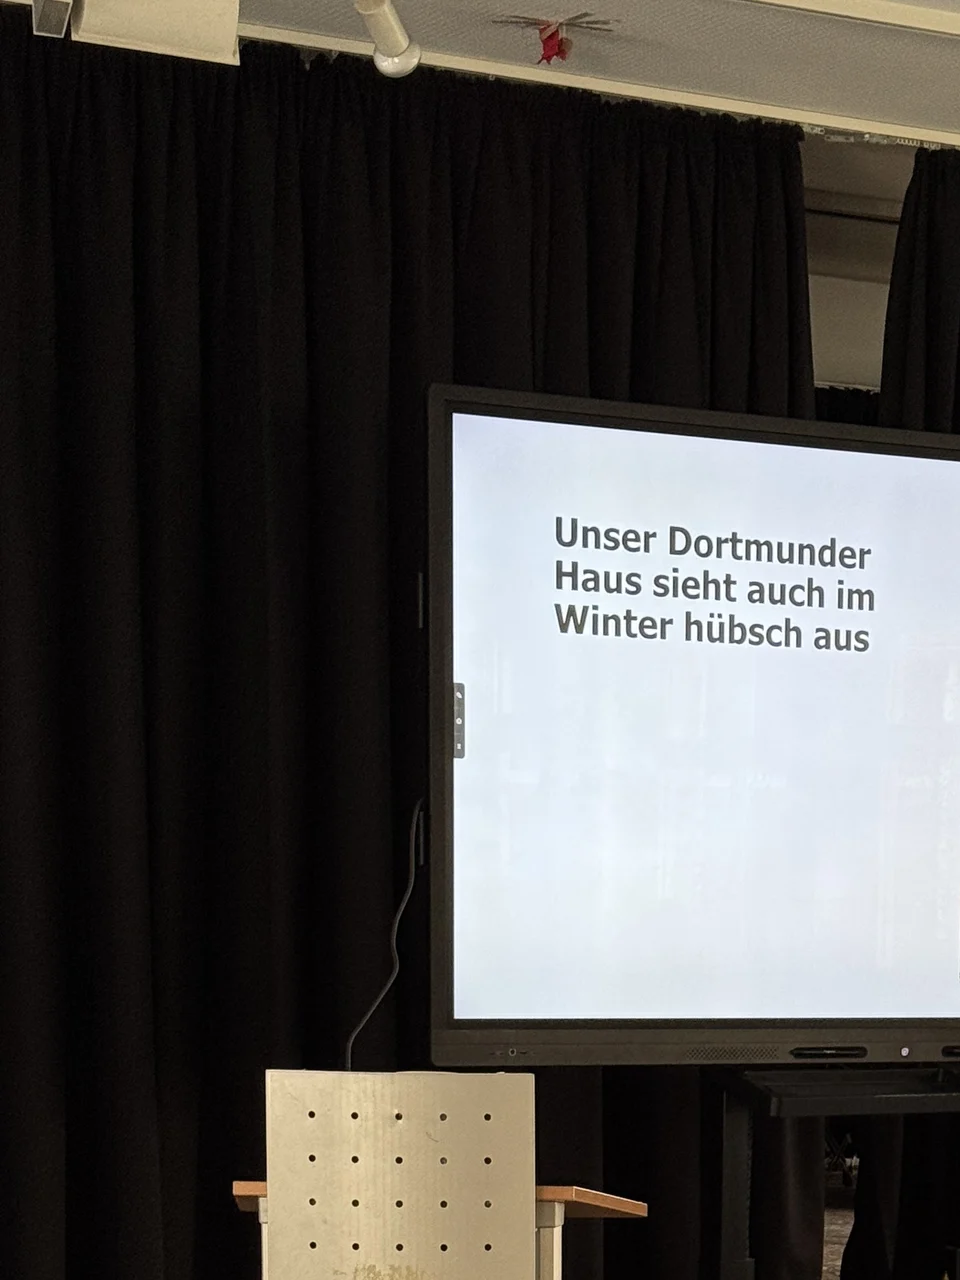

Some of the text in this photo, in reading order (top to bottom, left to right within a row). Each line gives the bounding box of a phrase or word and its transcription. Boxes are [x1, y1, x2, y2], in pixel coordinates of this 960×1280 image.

[555, 516, 872, 570] Unser Dortmunder
[555, 560, 874, 611] Haus sieht auch im
[554, 603, 869, 652] Winter hübsch aus
